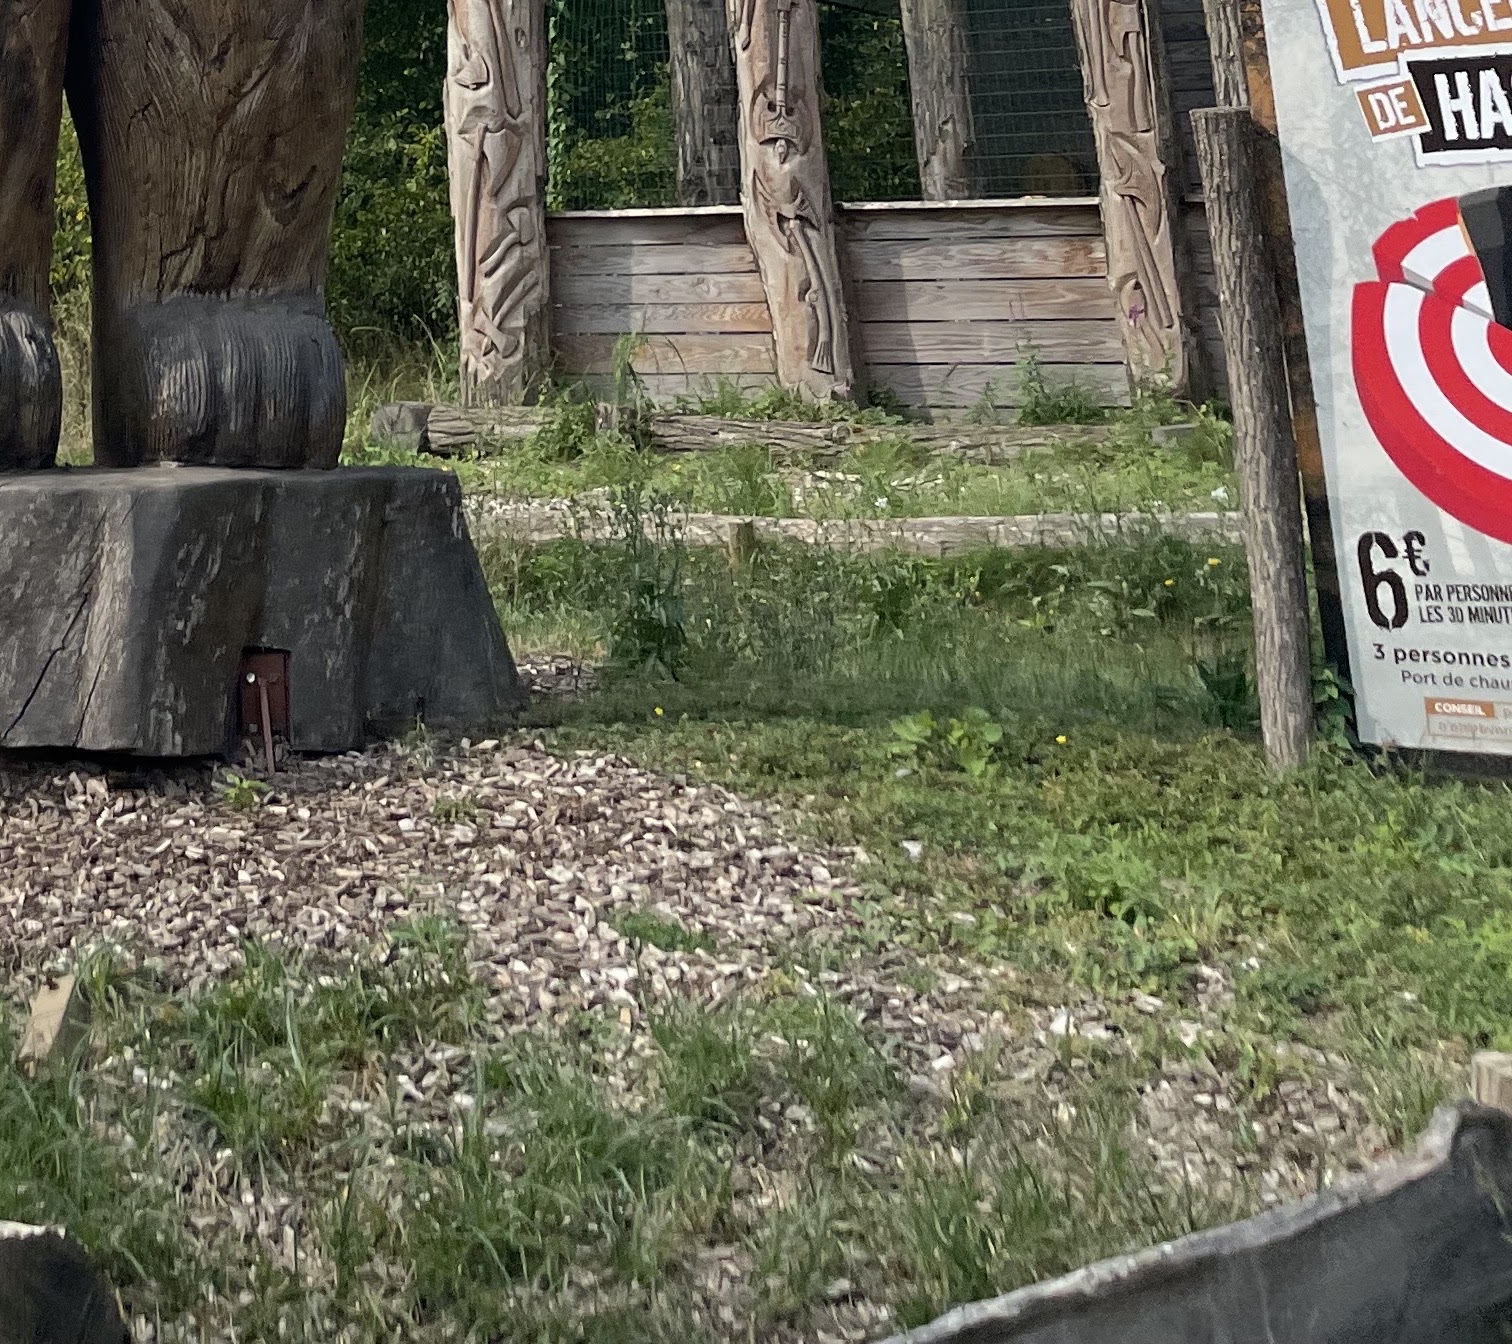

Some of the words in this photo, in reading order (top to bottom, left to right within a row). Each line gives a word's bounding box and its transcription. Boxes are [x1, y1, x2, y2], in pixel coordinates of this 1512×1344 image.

[1368, 87, 1416, 131] DE
[1434, 68, 1512, 141] HA
[1415, 584, 1443, 602] PAR
[1418, 605, 1444, 624] LES
[1448, 606, 1464, 624] 30
[1468, 606, 1512, 624] MINUT
[1372, 643, 1385, 660] 3
[1394, 648, 1511, 668] personnes
[1401, 670, 1437, 685] Port
[1443, 672, 1464, 686] de
[1470, 675, 1512, 691] chau
[1434, 702, 1486, 717] CONSEIL
